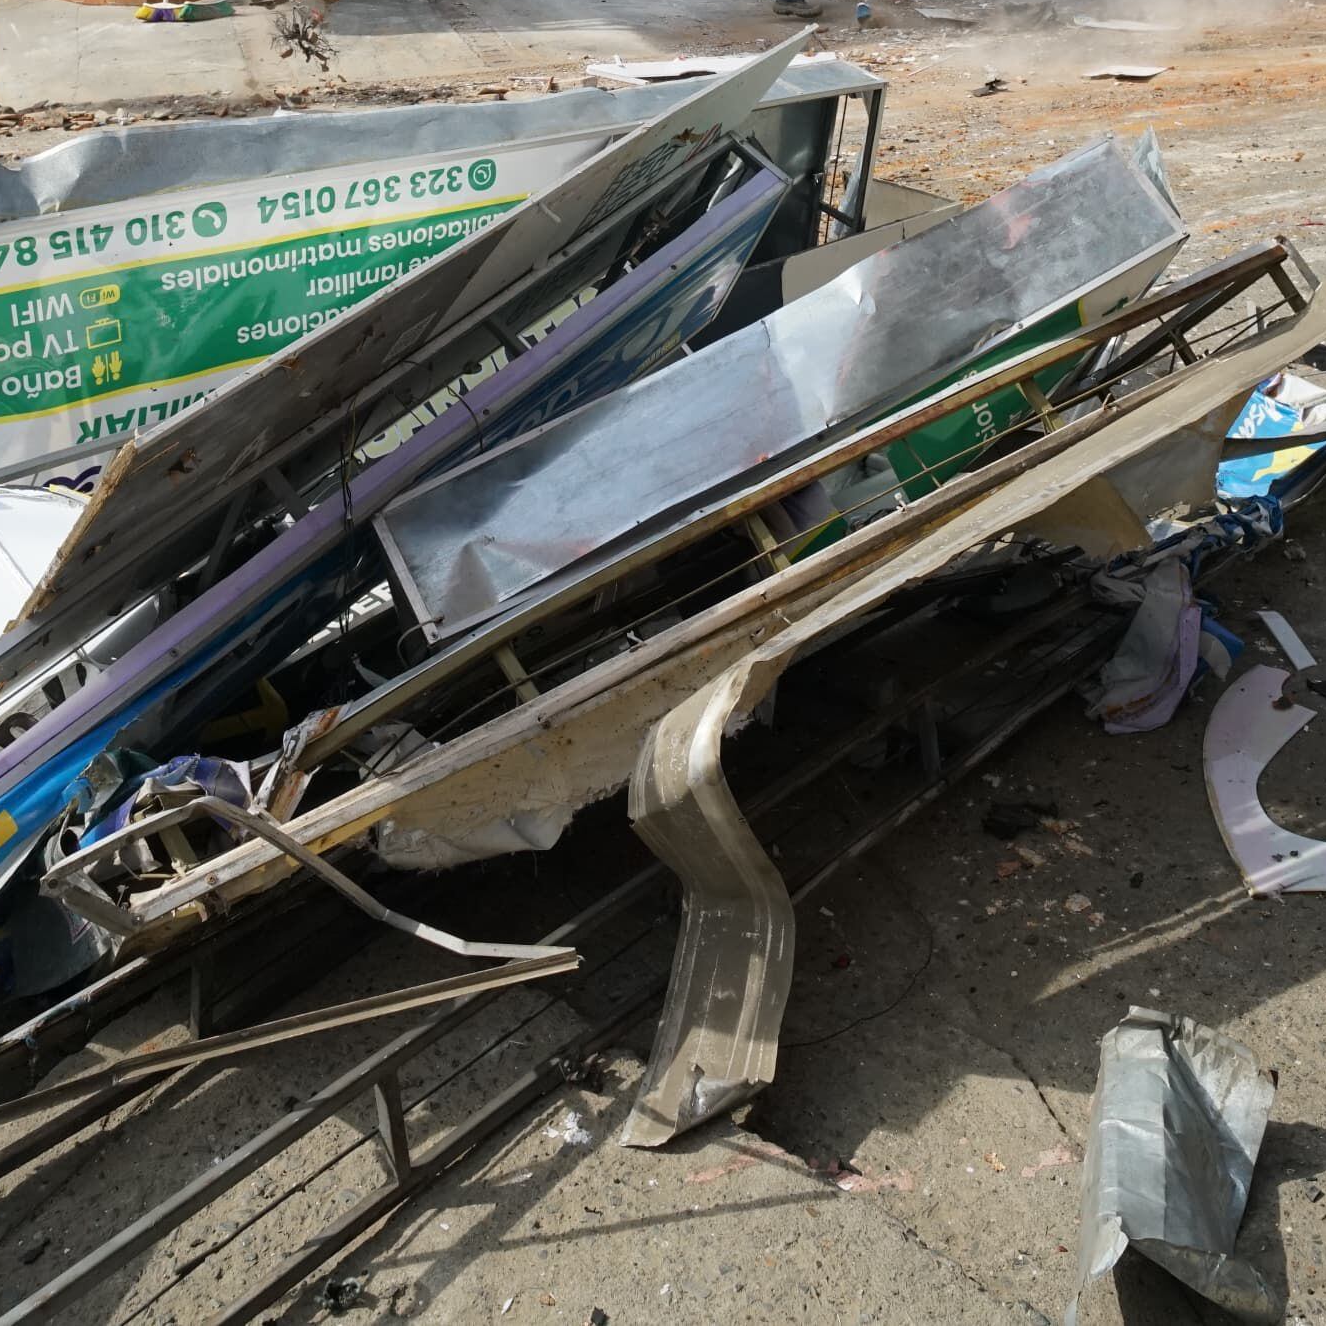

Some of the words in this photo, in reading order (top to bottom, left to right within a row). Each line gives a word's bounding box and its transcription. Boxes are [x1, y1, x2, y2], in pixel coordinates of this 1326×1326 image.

[344, 174, 401, 210] 367
[411, 164, 463, 200] 323
[257, 185, 336, 225] 0154
[49, 224, 114, 260] 415
[124, 210, 186, 247] 310
[161, 234, 361, 291] matrimoniales
[10, 292, 75, 328] WIFI
[42, 329, 80, 359] TV
[0, 364, 82, 399] Baño
